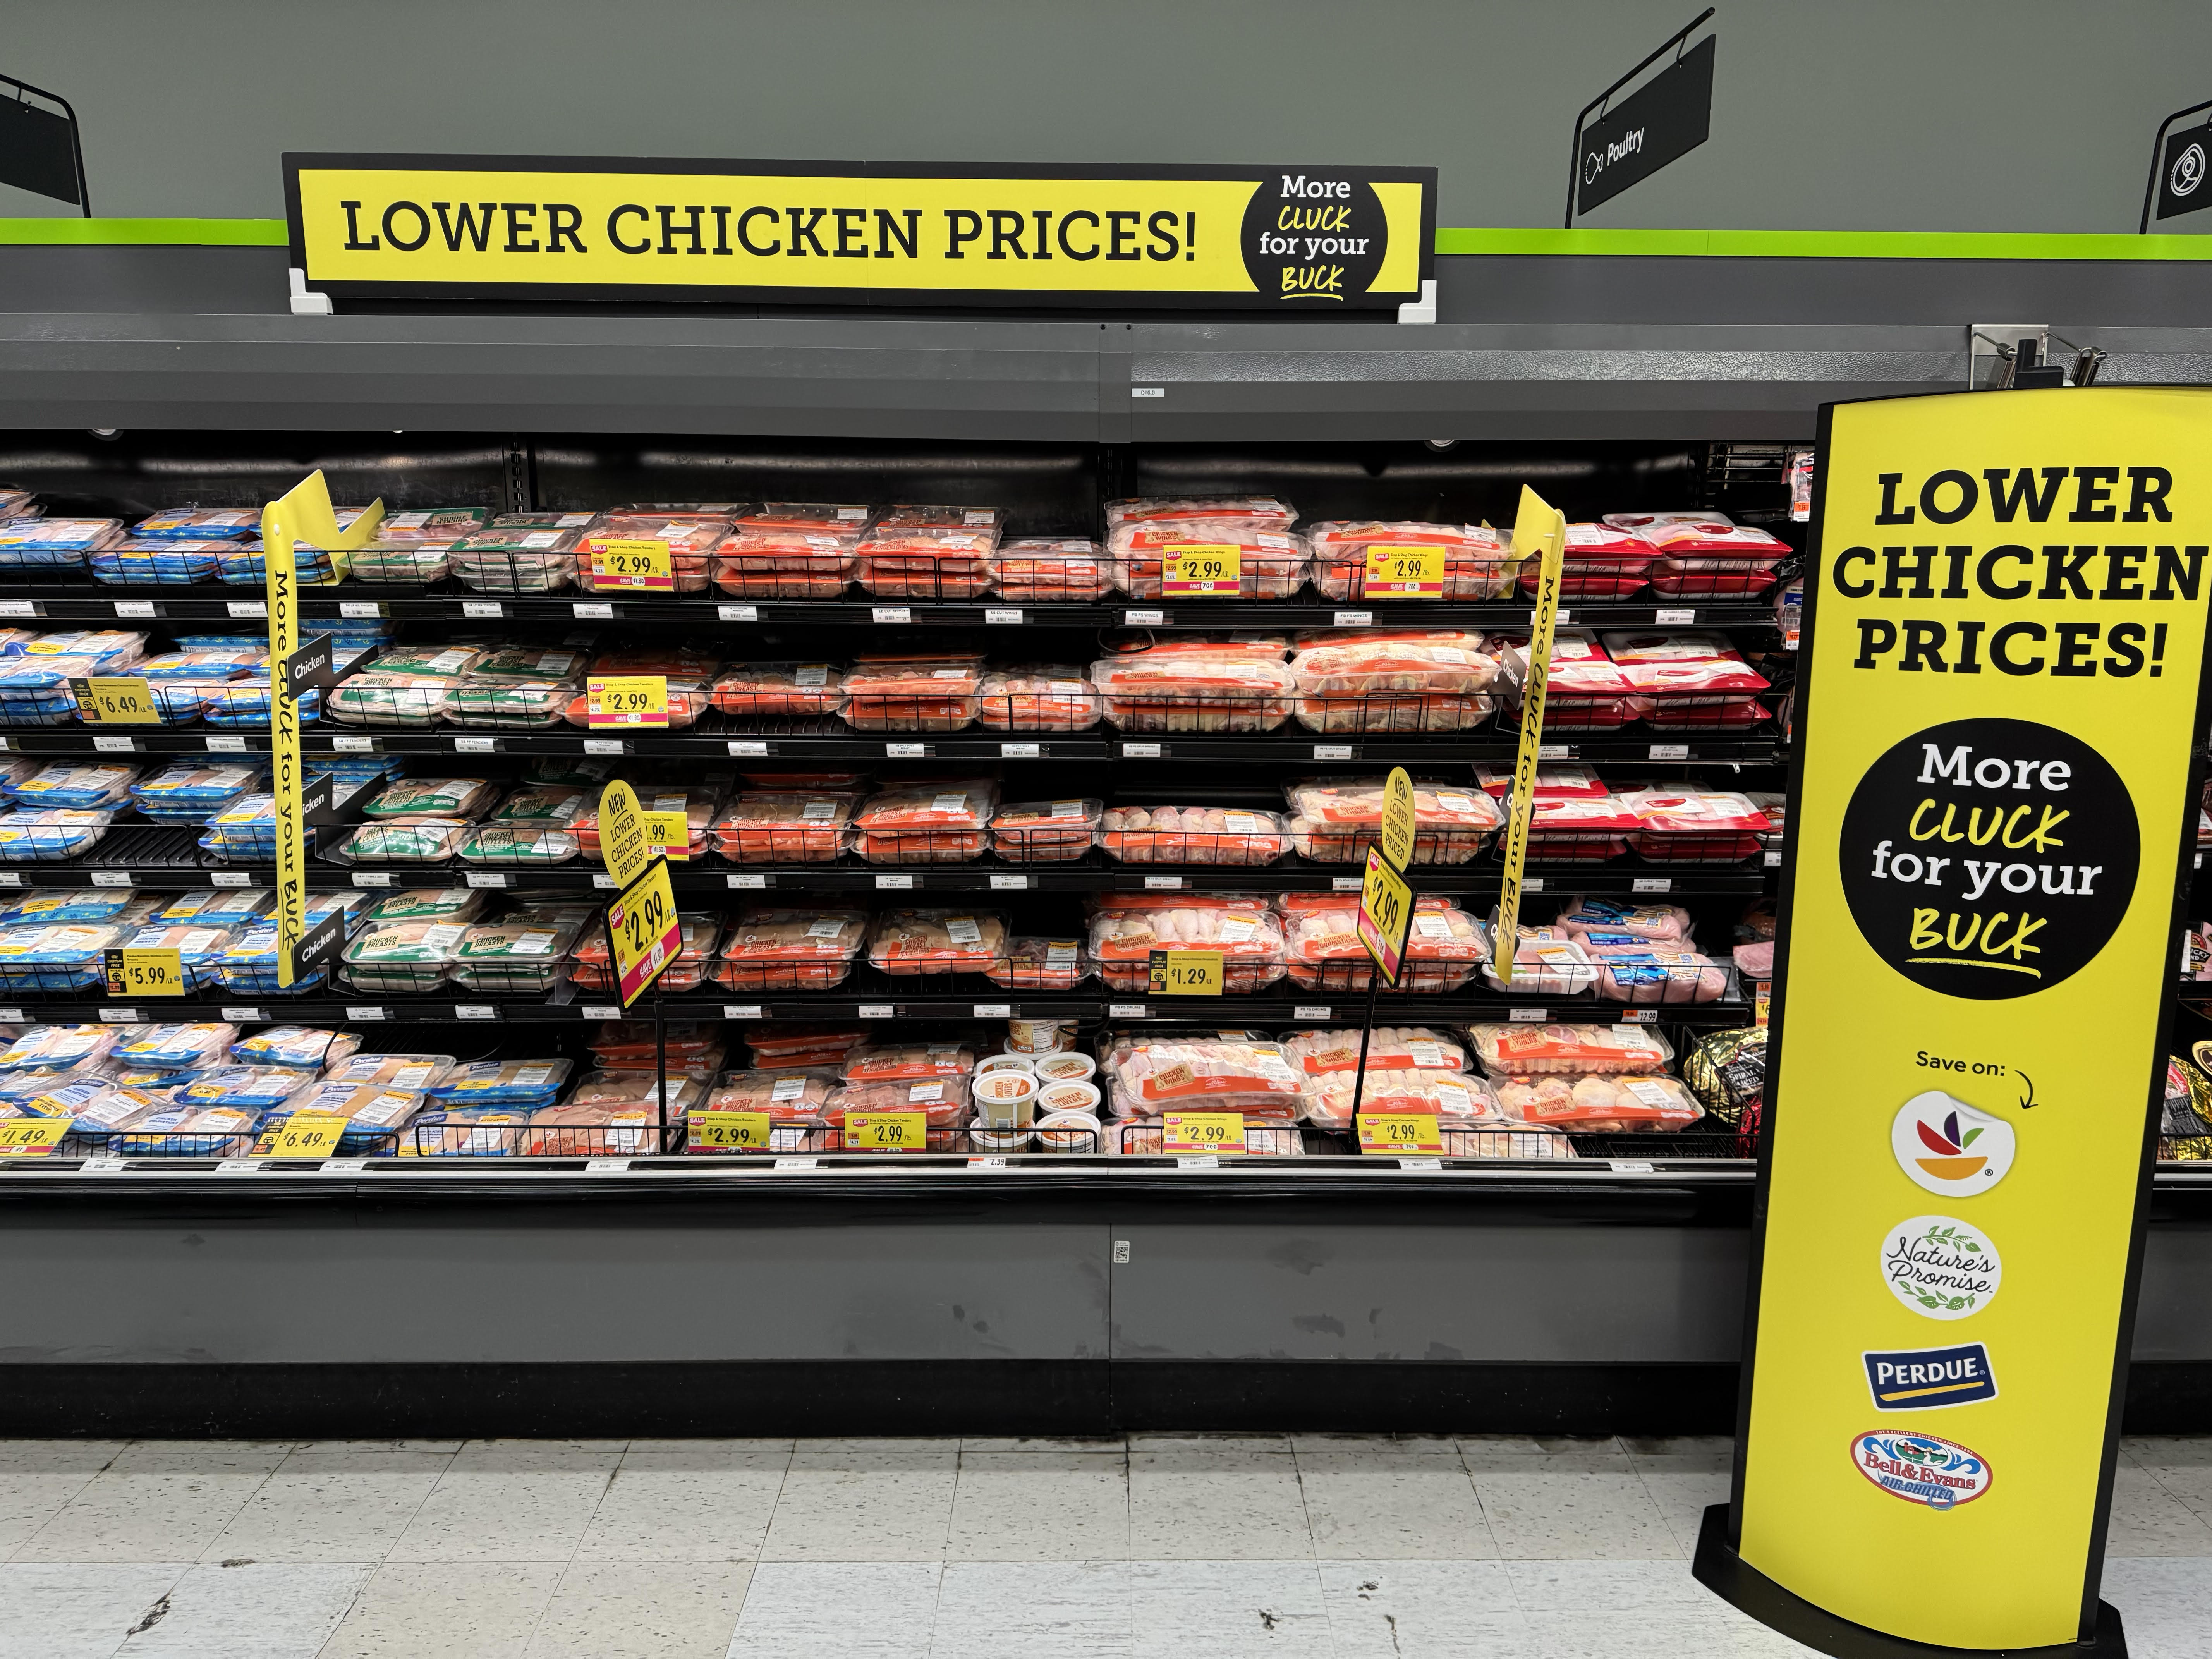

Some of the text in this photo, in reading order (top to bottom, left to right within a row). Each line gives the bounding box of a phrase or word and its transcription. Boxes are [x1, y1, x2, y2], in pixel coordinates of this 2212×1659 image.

[1607, 127, 1644, 166] Poultry
[1280, 175, 1350, 198] More
[342, 199, 1197, 264] LOWER CHICKEN PRICES!
[1278, 206, 1351, 232] CLUCK
[1259, 232, 1369, 260] for your
[1281, 265, 1344, 292] BUCK
[1875, 467, 2173, 525] LOWER
[610, 556, 650, 573] $2.99
[1183, 562, 1221, 577] $2.99
[1395, 560, 1421, 576] $2.99
[1833, 545, 2209, 601] CHICKEN
[275, 570, 288, 651] More
[1854, 619, 2168, 678] PRICES!
[295, 653, 325, 679] Chicken
[1503, 658, 1519, 687] Chicken
[99, 696, 137, 713] $6.49
[607, 694, 647, 709] $2.99
[282, 752, 292, 796] for
[1503, 575, 1554, 950] More CLUCK for your BUCK
[1917, 743, 2071, 791] More
[1394, 776, 1408, 800] NEW
[302, 792, 325, 815] icken
[608, 788, 625, 817] NEW
[1389, 800, 1408, 827] LOWER
[280, 803, 293, 872] your
[610, 813, 635, 843] LOWER
[646, 824, 665, 840] .99
[1385, 814, 1409, 847] CHICKEN
[1909, 798, 2070, 853] CLUCK
[611, 827, 643, 863] CHICKEN
[1385, 832, 1405, 862] PRICES!
[618, 847, 645, 879] PRICES!
[1871, 840, 2102, 900] for your
[285, 879, 298, 950] BUCK
[611, 905, 624, 926] SALE
[1372, 874, 1398, 936] $2.99
[625, 891, 663, 952] $2.99
[1910, 908, 2047, 960] BUCK
[302, 927, 336, 962] Chicken
[129, 967, 165, 984] $5.99
[640, 958, 652, 979] SAVE
[1171, 968, 1206, 984] $1.29
[1320, 1050, 1346, 1059] CHICKEN
[1916, 1051, 2006, 1077] Save on:
[1159, 1066, 1185, 1080] CHICKEN
[1164, 1074, 1185, 1085] WINGS
[1051, 1091, 1081, 1104] CHICKEN
[1059, 1096, 1083, 1107] LIVERS
[2, 1130, 45, 1143] $1.49
[283, 1132, 323, 1147] $6.49
[708, 1127, 749, 1143] $2.99
[874, 1125, 902, 1142] $2.99
[1184, 1127, 1224, 1140] $2.99
[1387, 1124, 1414, 1139] $2.99
[1886, 1236, 1996, 1273] Nature's
[1888, 1259, 1991, 1293] Promise
[1877, 1357, 1978, 1385] PERDUE
[1918, 1434, 1942, 1442] CHICKEN
[1863, 1451, 1976, 1490] Bell&Evans
